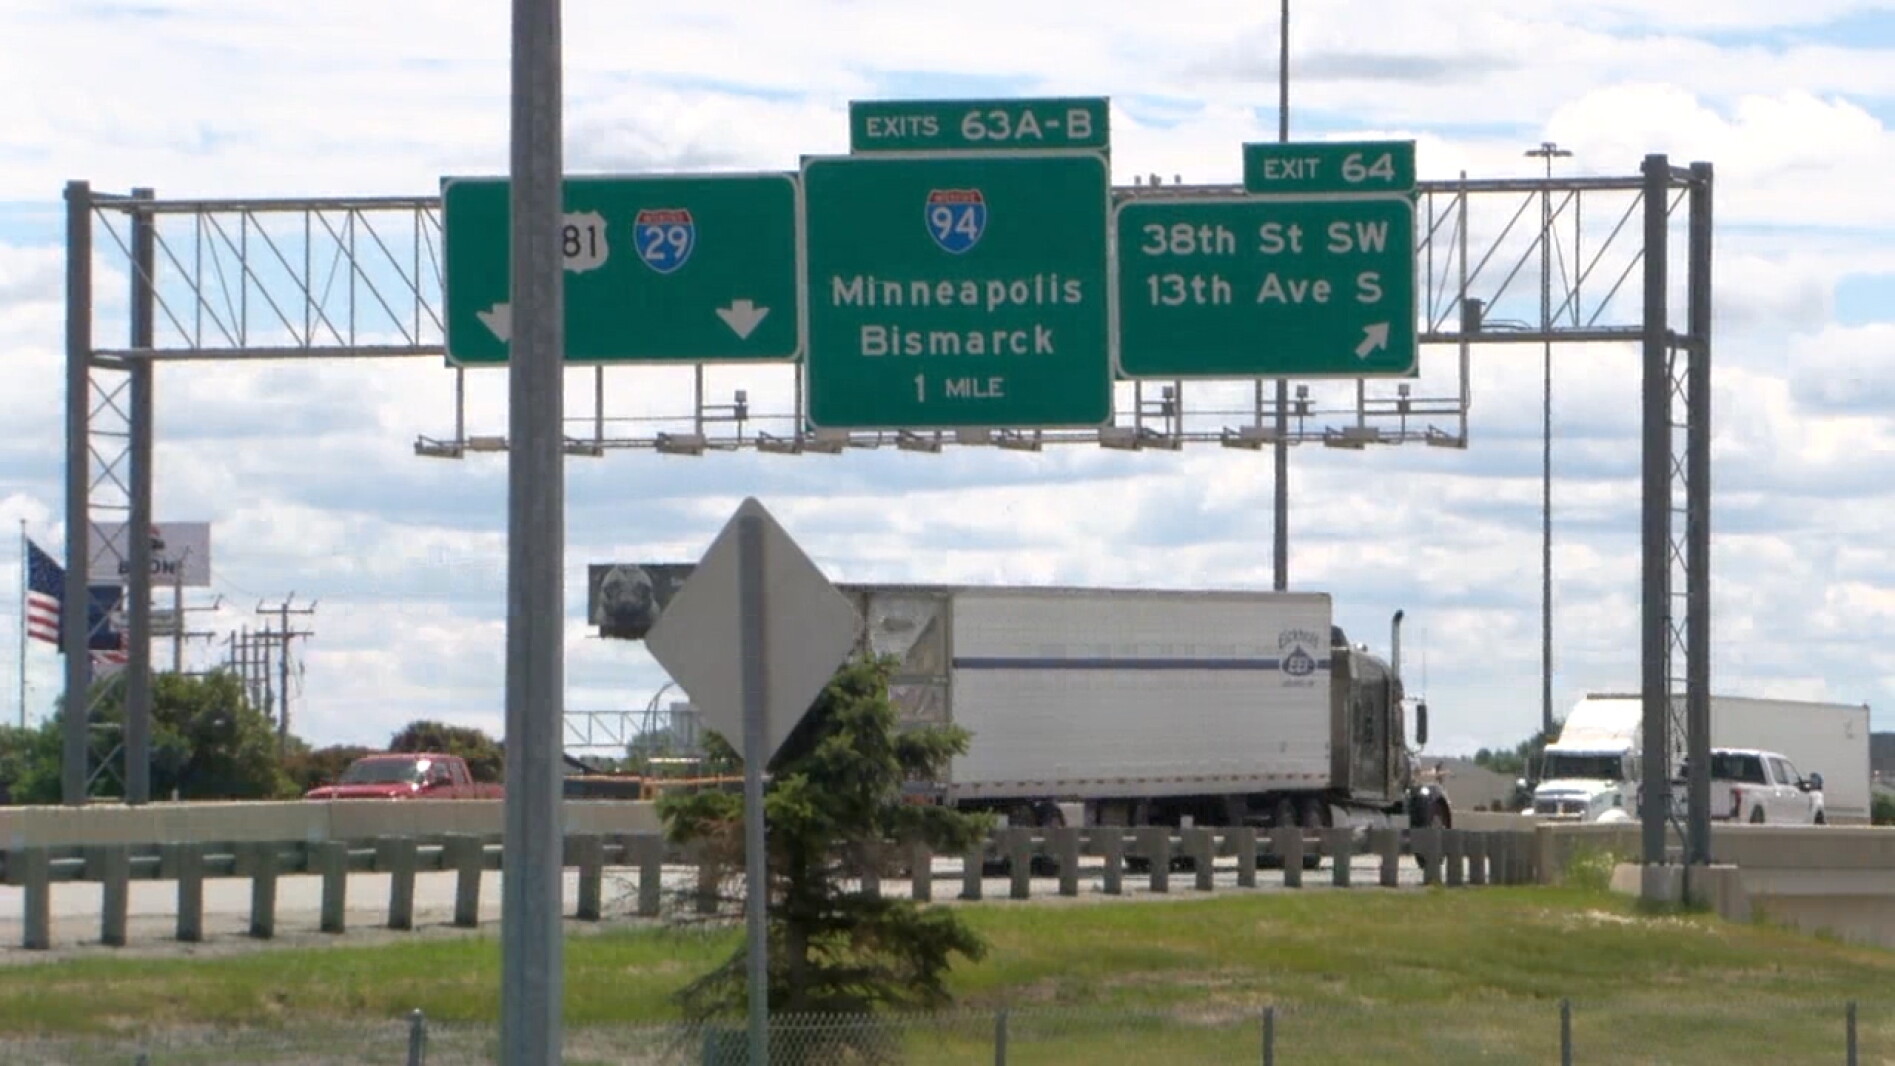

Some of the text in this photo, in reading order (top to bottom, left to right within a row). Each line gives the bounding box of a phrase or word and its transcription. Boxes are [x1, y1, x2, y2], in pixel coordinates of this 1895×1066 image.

[866, 108, 1092, 140] EXITS 63A-B
[1263, 152, 1396, 183] EXIT 64
[562, 223, 597, 258] 81
[931, 205, 978, 241] 94
[1142, 221, 1388, 256] 38th St SW
[645, 225, 689, 260] 29
[832, 273, 1083, 312] Minneapolis
[1147, 271, 1383, 306] 13th Ave S
[860, 324, 1055, 356] Bismarck
[914, 373, 1005, 402] 1 MILE
